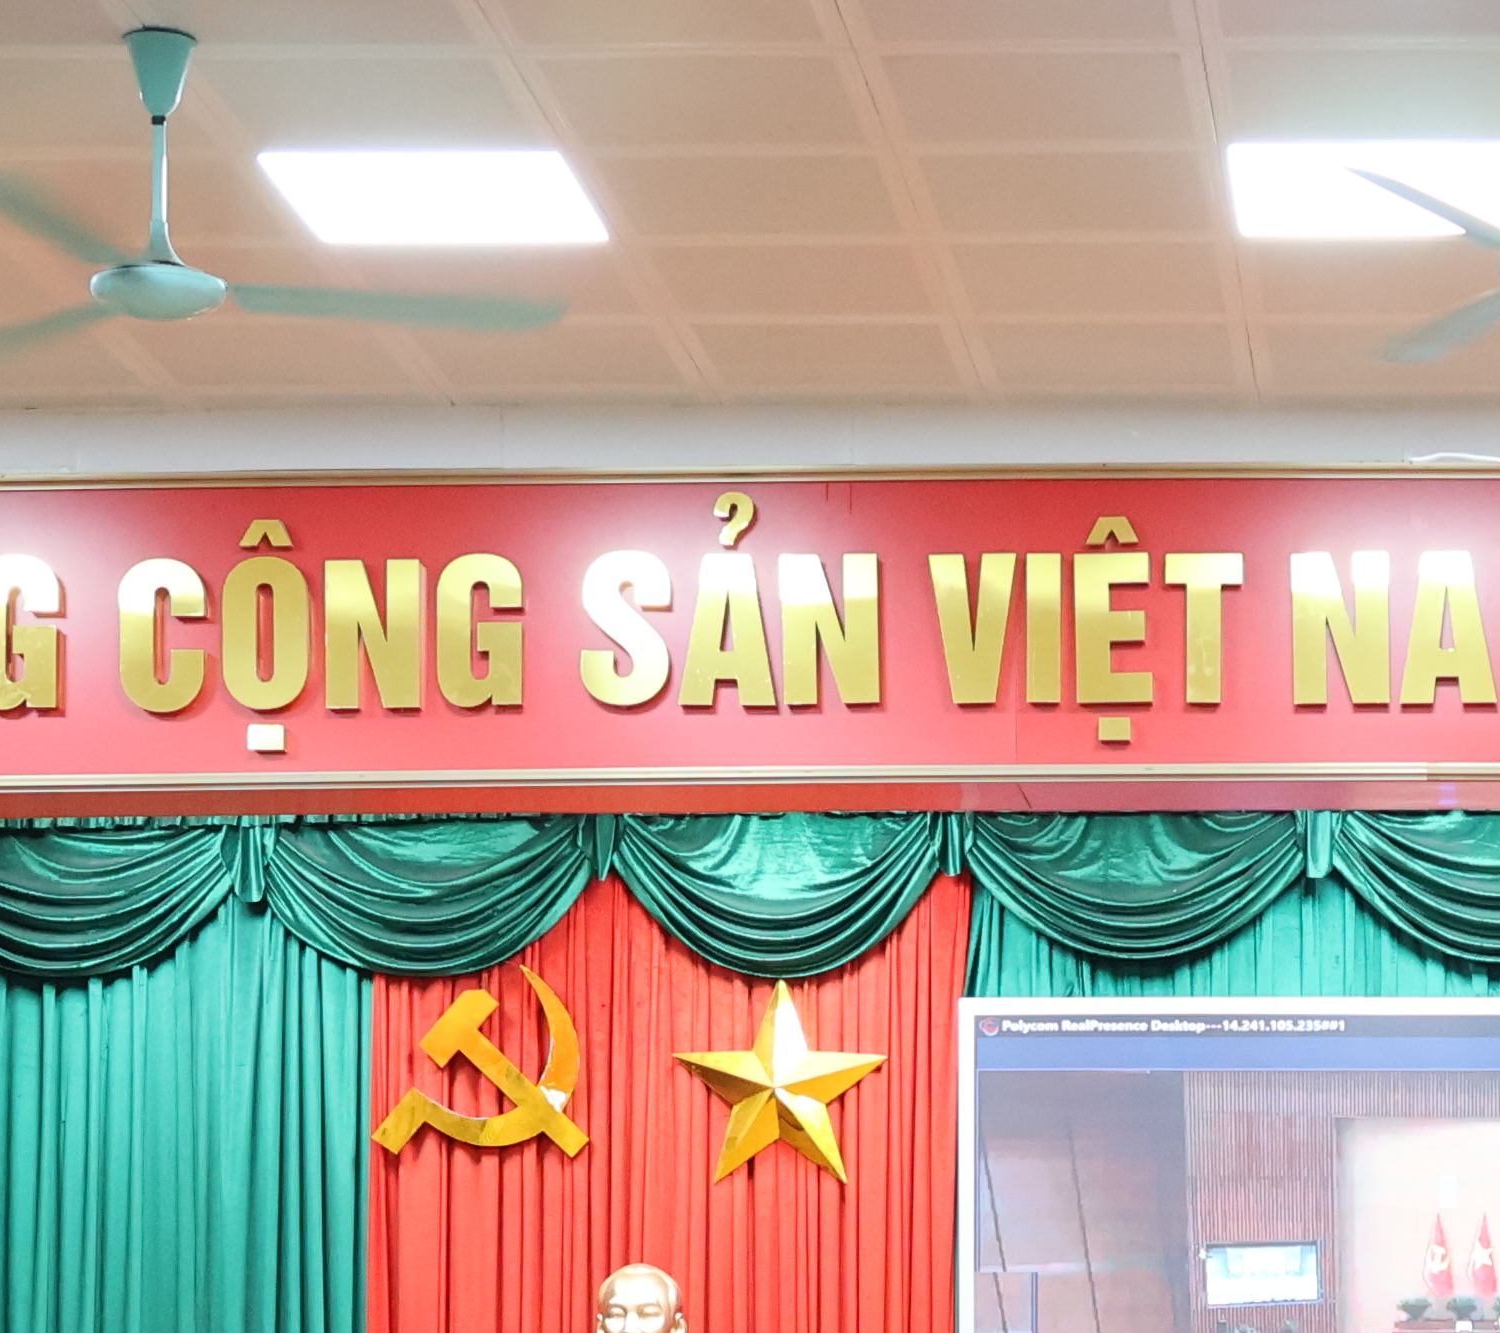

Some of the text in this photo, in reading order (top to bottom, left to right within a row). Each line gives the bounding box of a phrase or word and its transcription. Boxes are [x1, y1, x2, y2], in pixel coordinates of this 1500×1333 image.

[117, 518, 525, 753] CỘNG
[579, 491, 880, 708] SẢN
[928, 515, 1245, 743] VIỆT
[1002, 1020, 1058, 1033] Polycom
[1061, 1020, 1148, 1032] RealPresence
